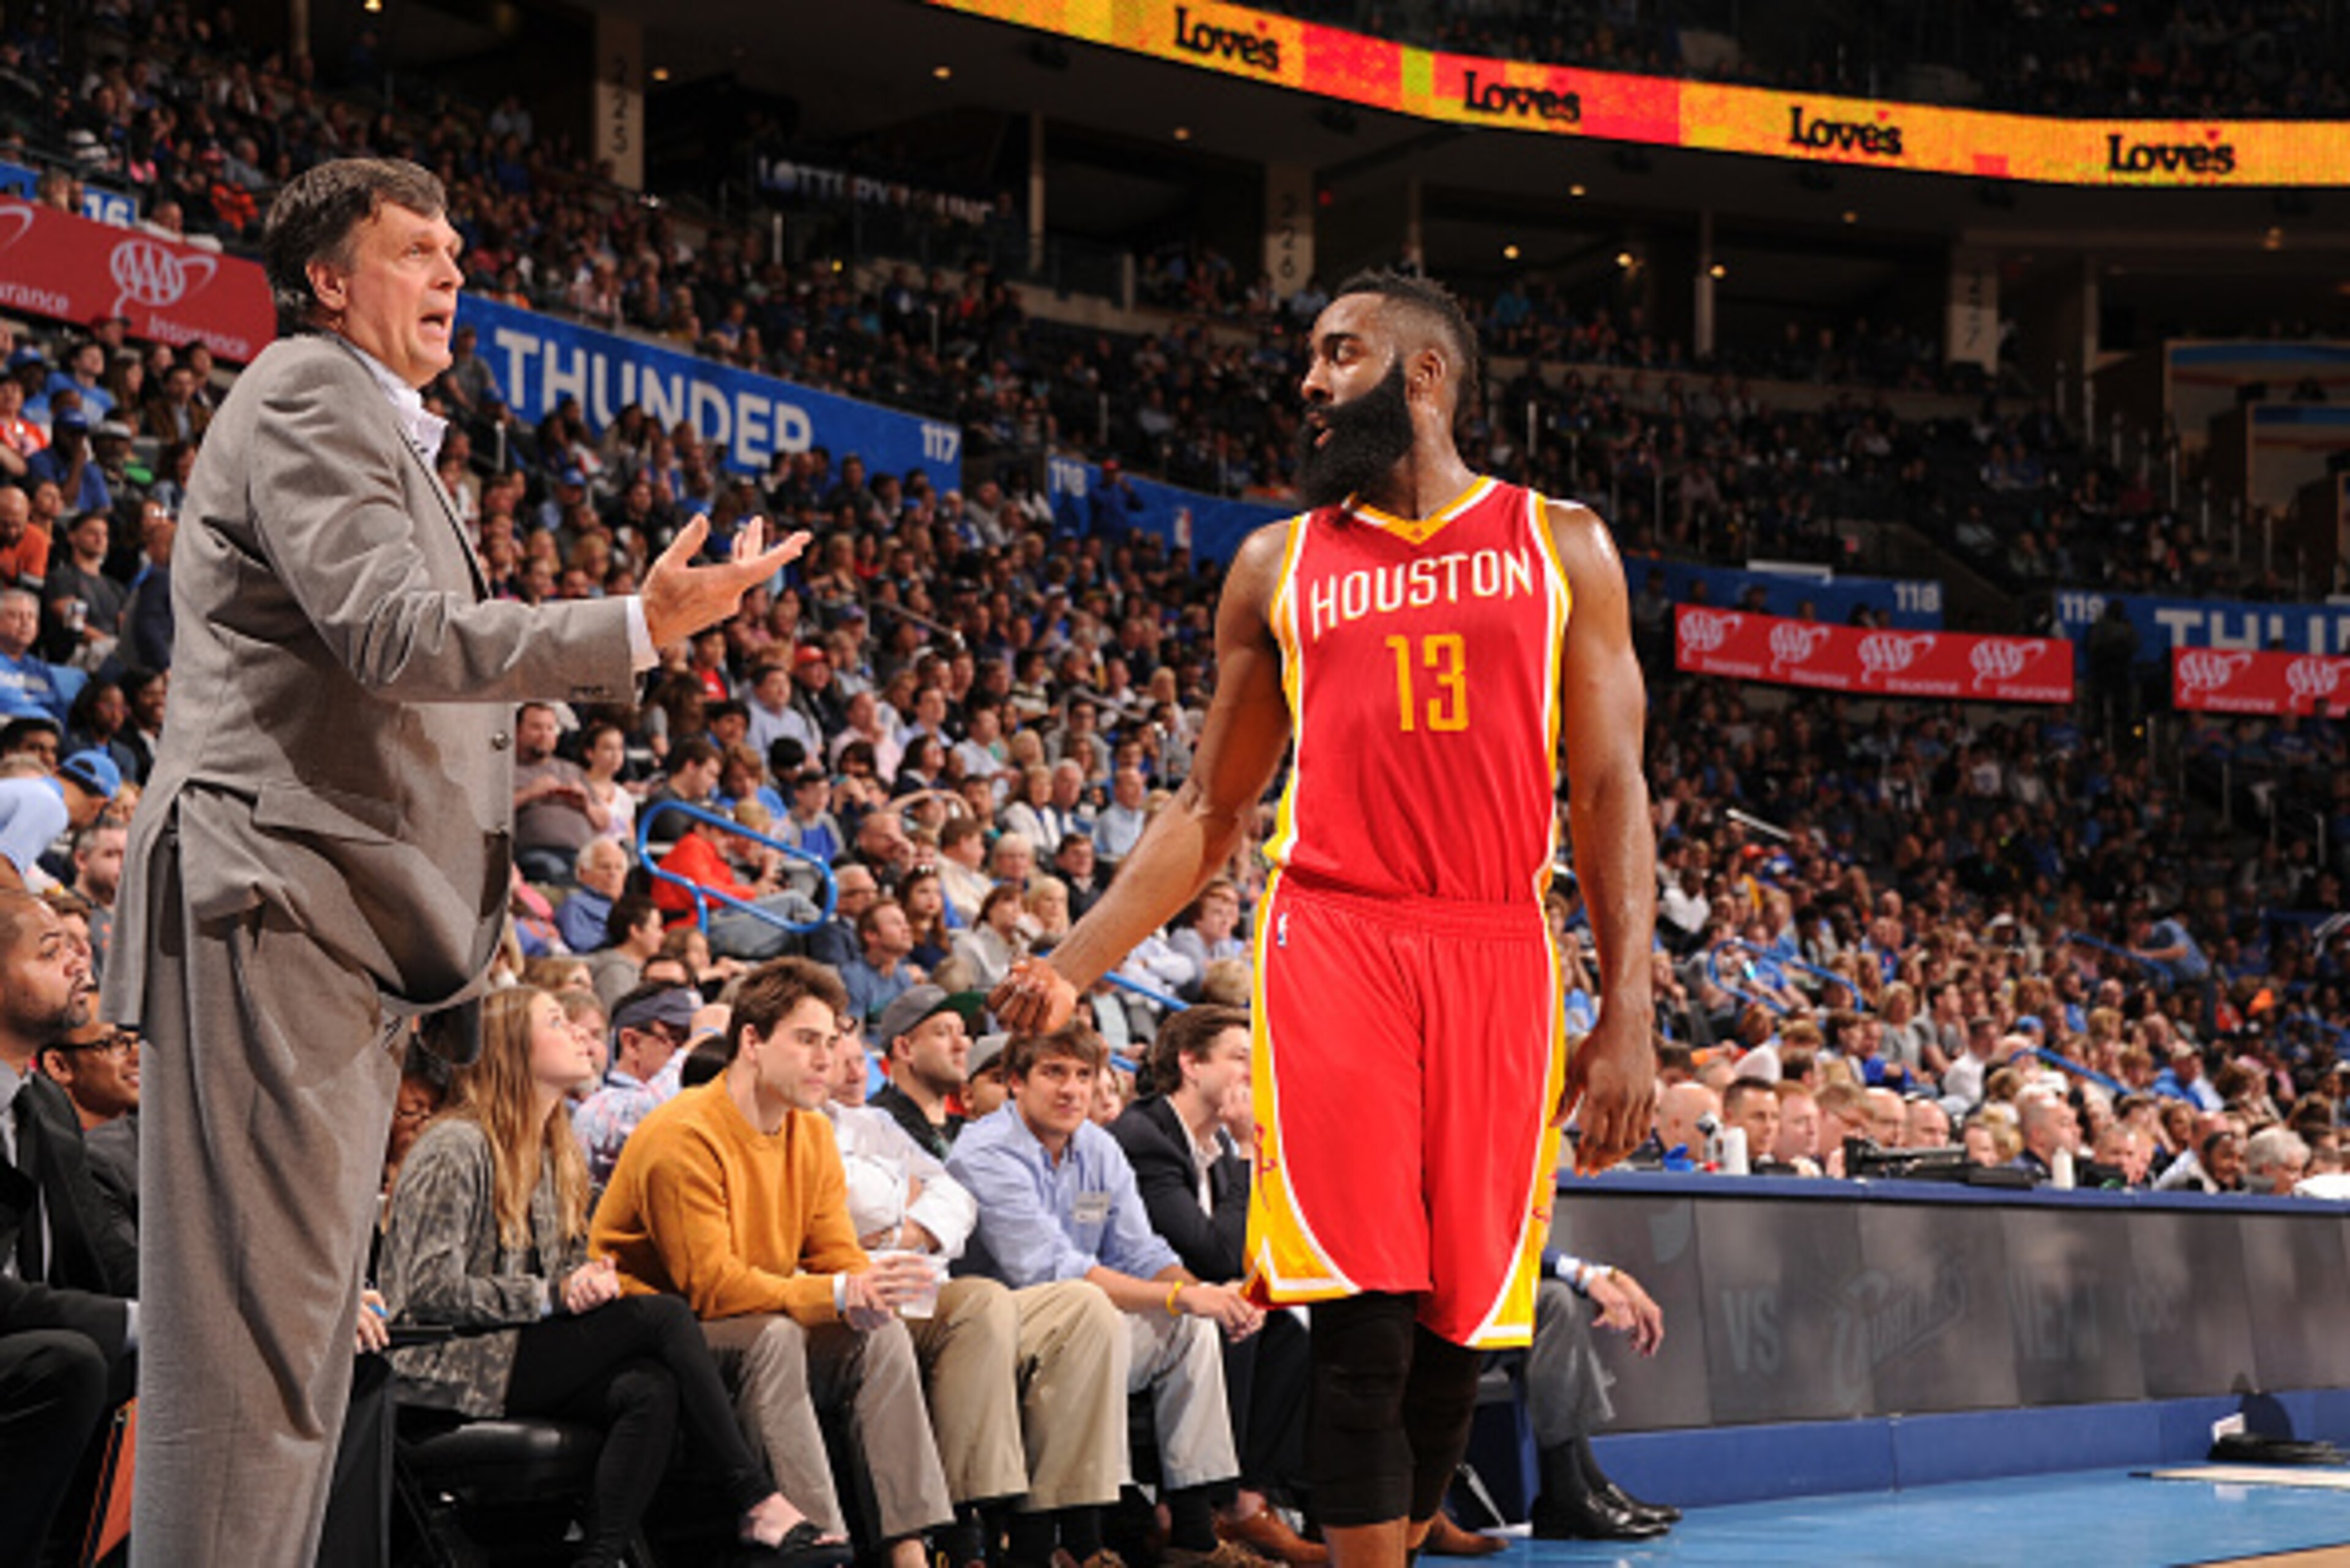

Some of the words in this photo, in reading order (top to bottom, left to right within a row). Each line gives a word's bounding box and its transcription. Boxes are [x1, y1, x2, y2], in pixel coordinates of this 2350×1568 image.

[920, 424, 960, 463] 117
[1310, 546, 1533, 643] HOUSTON
[1386, 633, 1469, 732] 13
[1721, 1290, 1781, 1375] VS
